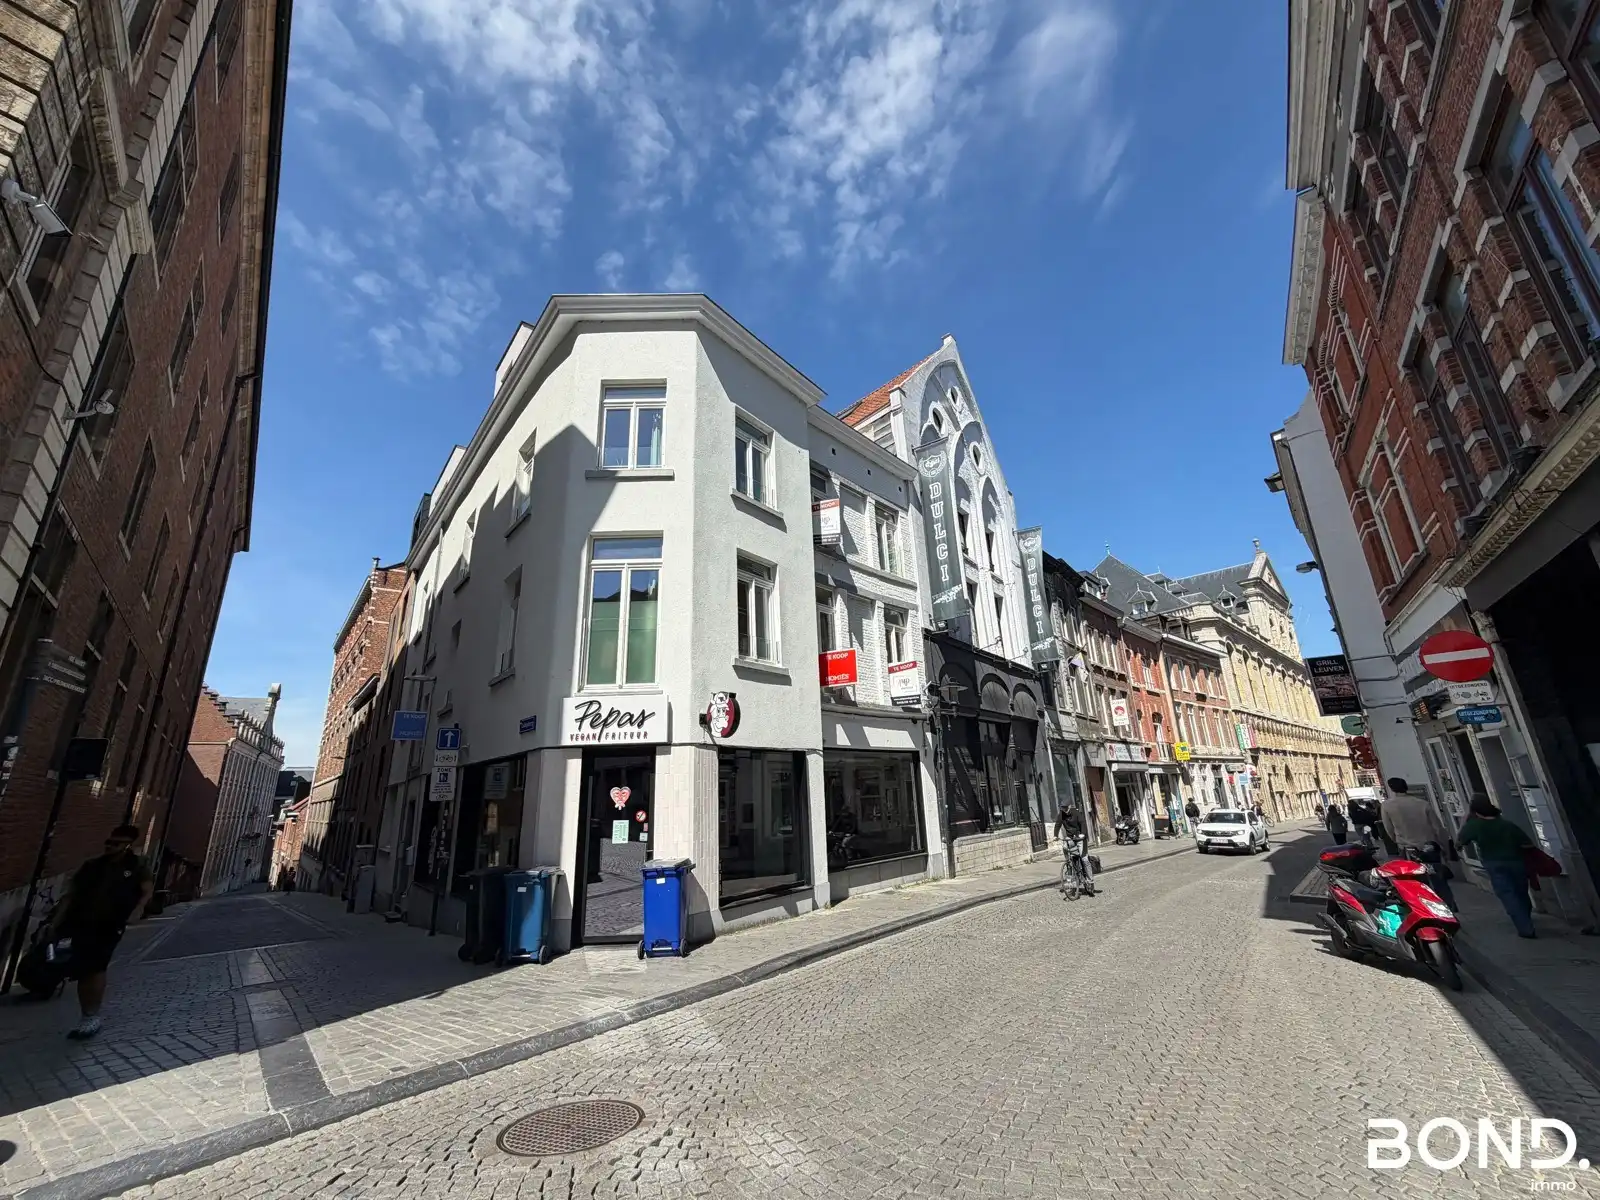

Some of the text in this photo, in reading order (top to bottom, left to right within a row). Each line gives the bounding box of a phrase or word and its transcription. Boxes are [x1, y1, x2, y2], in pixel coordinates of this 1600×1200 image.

[929, 481, 949, 582] DULCI
[1027, 558, 1043, 634] DULCI
[832, 652, 849, 660] KOOP
[1314, 665, 1344, 673] LEUVEN
[574, 700, 656, 742] Pepas
[570, 731, 649, 742] VEGAN FRITUUR
